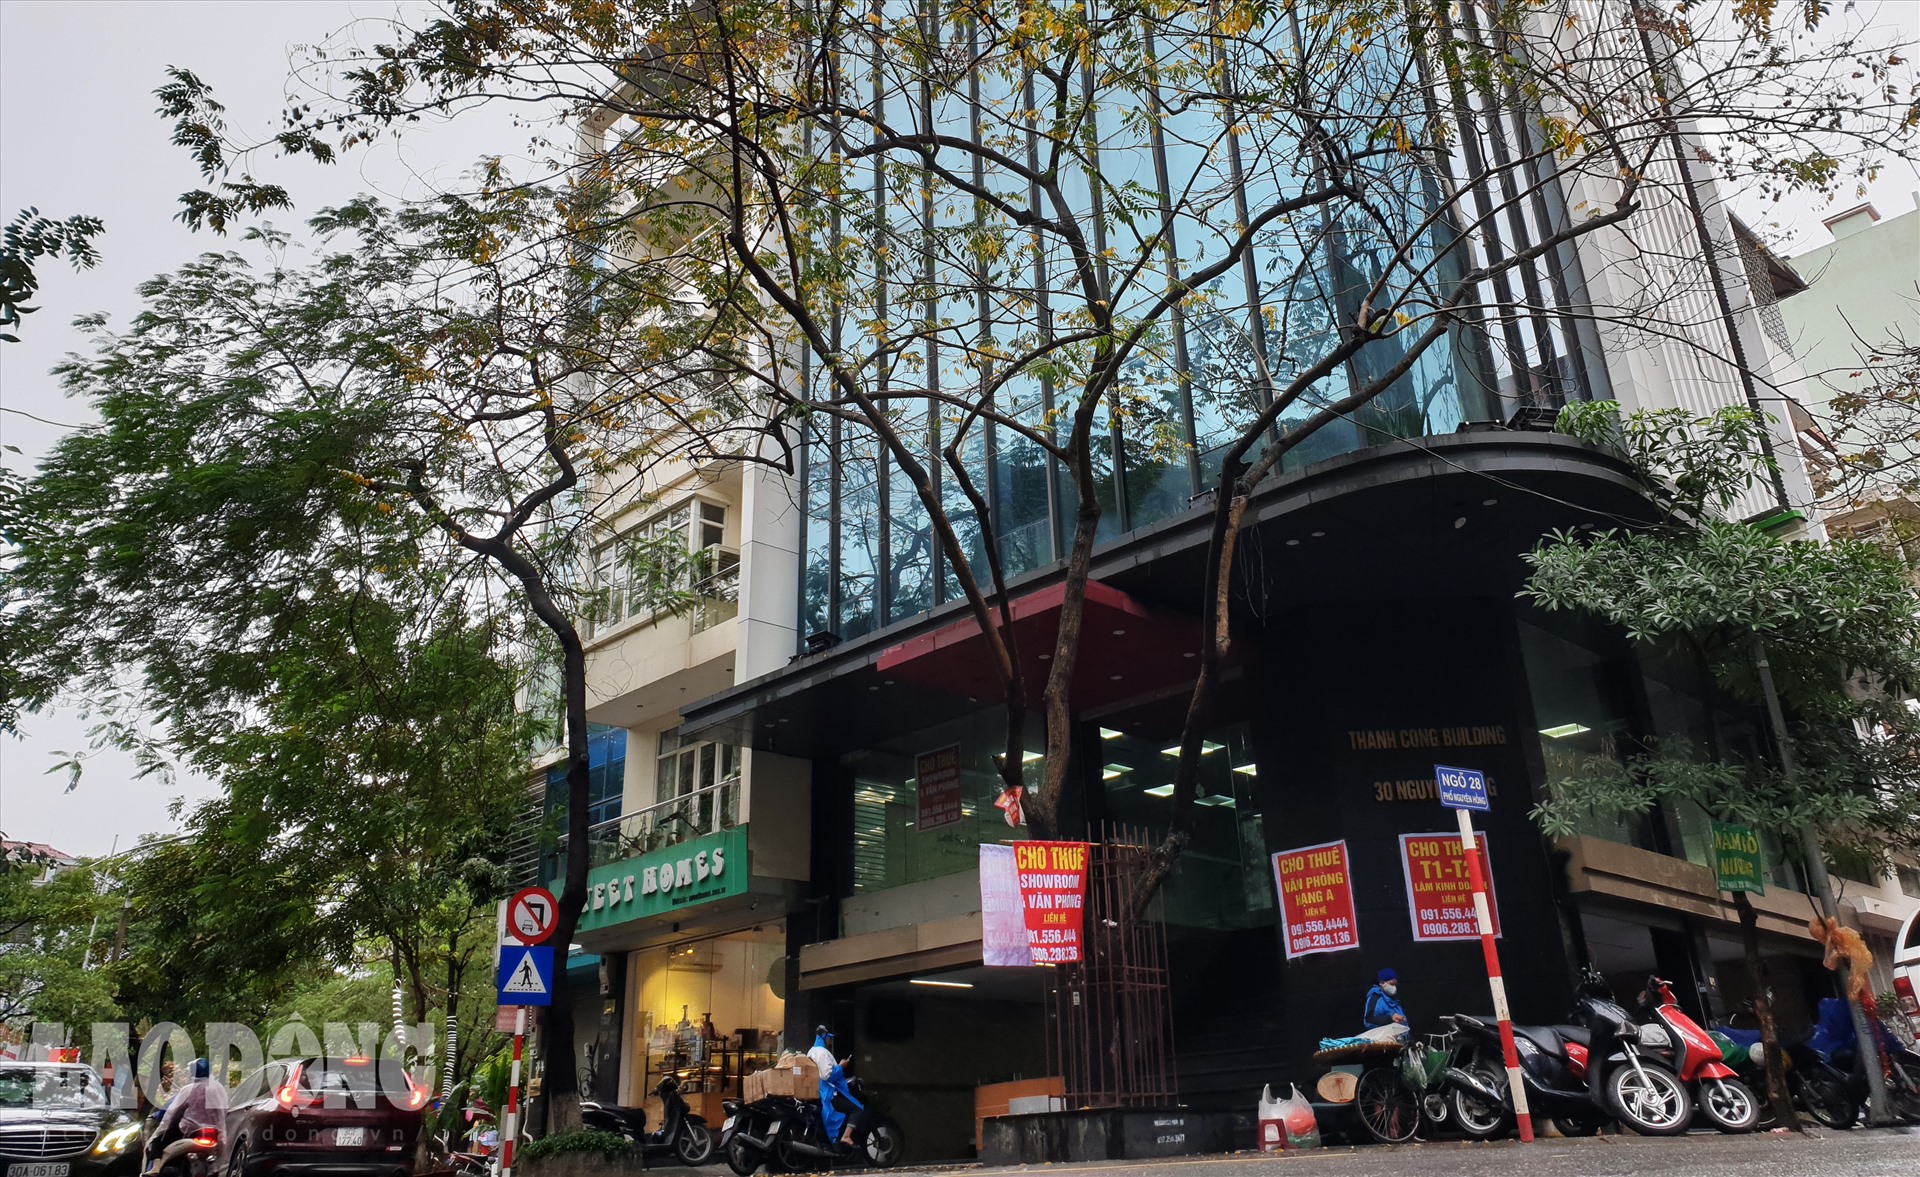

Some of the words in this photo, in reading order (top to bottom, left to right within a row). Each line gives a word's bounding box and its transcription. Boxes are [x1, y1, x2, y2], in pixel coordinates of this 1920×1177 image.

[1348, 730, 1397, 750] THANH
[1400, 728, 1438, 748] CONG
[1442, 726, 1506, 746] BUILDING
[1441, 772, 1466, 788] NGÕ
[1469, 776, 1482, 790] 28
[1374, 781, 1393, 801] 30
[1017, 846, 1046, 870] CHO
[1050, 843, 1085, 870] THUÊ
[1409, 842, 1439, 857] CHO
[1281, 856, 1304, 875] CHO
[1307, 847, 1341, 869] THUÊ
[642, 847, 725, 895] HOMES
[1284, 877, 1302, 893] VĂN
[1306, 871, 1344, 889] PHÒNG
[1415, 881, 1433, 892] LÀM
[1436, 882, 1456, 891] KINH
[1028, 891, 1052, 909] VĂN
[1295, 891, 1323, 907] HẠNG
[1326, 889, 1334, 901] A
[1043, 912, 1059, 923] LIÊN
[1291, 917, 1348, 936] 091.556.4444
[1293, 931, 1350, 950] 0906.288.136
